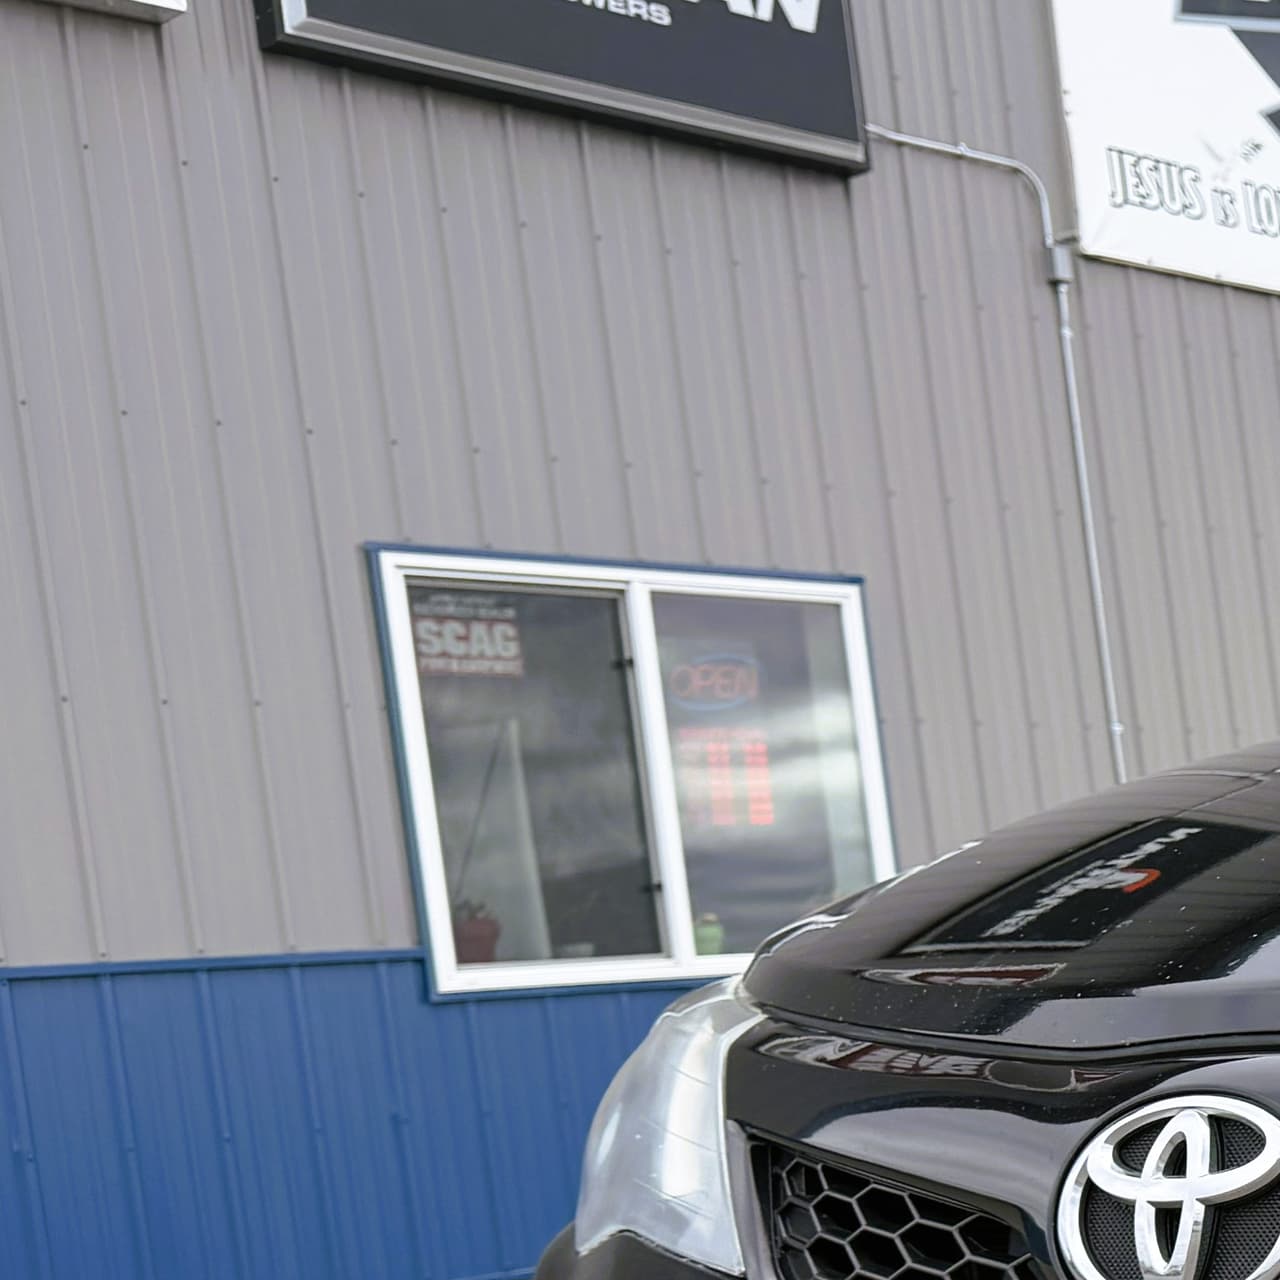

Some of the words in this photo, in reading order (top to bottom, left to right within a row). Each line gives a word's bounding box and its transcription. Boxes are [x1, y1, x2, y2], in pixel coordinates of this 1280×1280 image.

[1106, 146, 1207, 221] JESUS
[415, 620, 519, 657] SCAG
[671, 664, 759, 698] OPEN
